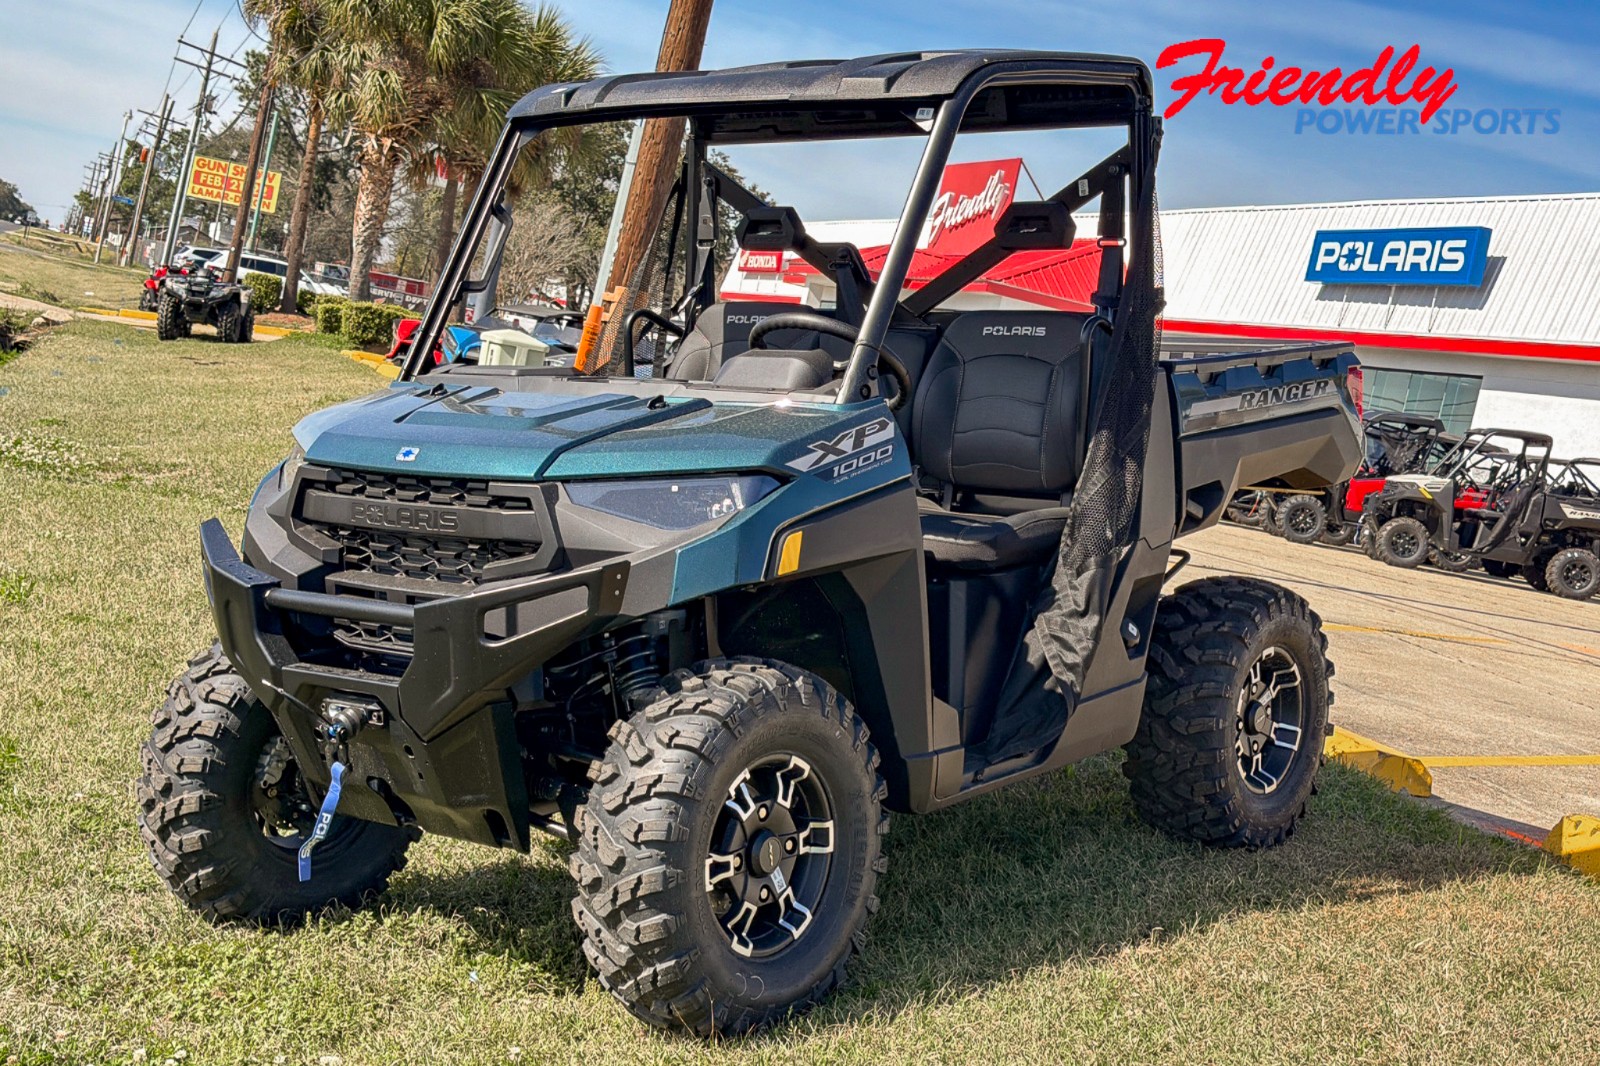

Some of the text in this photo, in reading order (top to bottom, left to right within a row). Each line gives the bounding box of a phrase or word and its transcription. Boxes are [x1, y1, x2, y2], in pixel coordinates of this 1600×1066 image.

[196, 158, 227, 174] GUN
[928, 169, 1010, 244] Friendly
[747, 255, 777, 268] HONDA
[1314, 239, 1468, 272] POLARIS
[982, 325, 1047, 336] POLARIS
[1237, 379, 1330, 411] RANGER
[793, 417, 895, 472] XP
[833, 444, 893, 478] 1000
[350, 502, 460, 532] POLARIS
